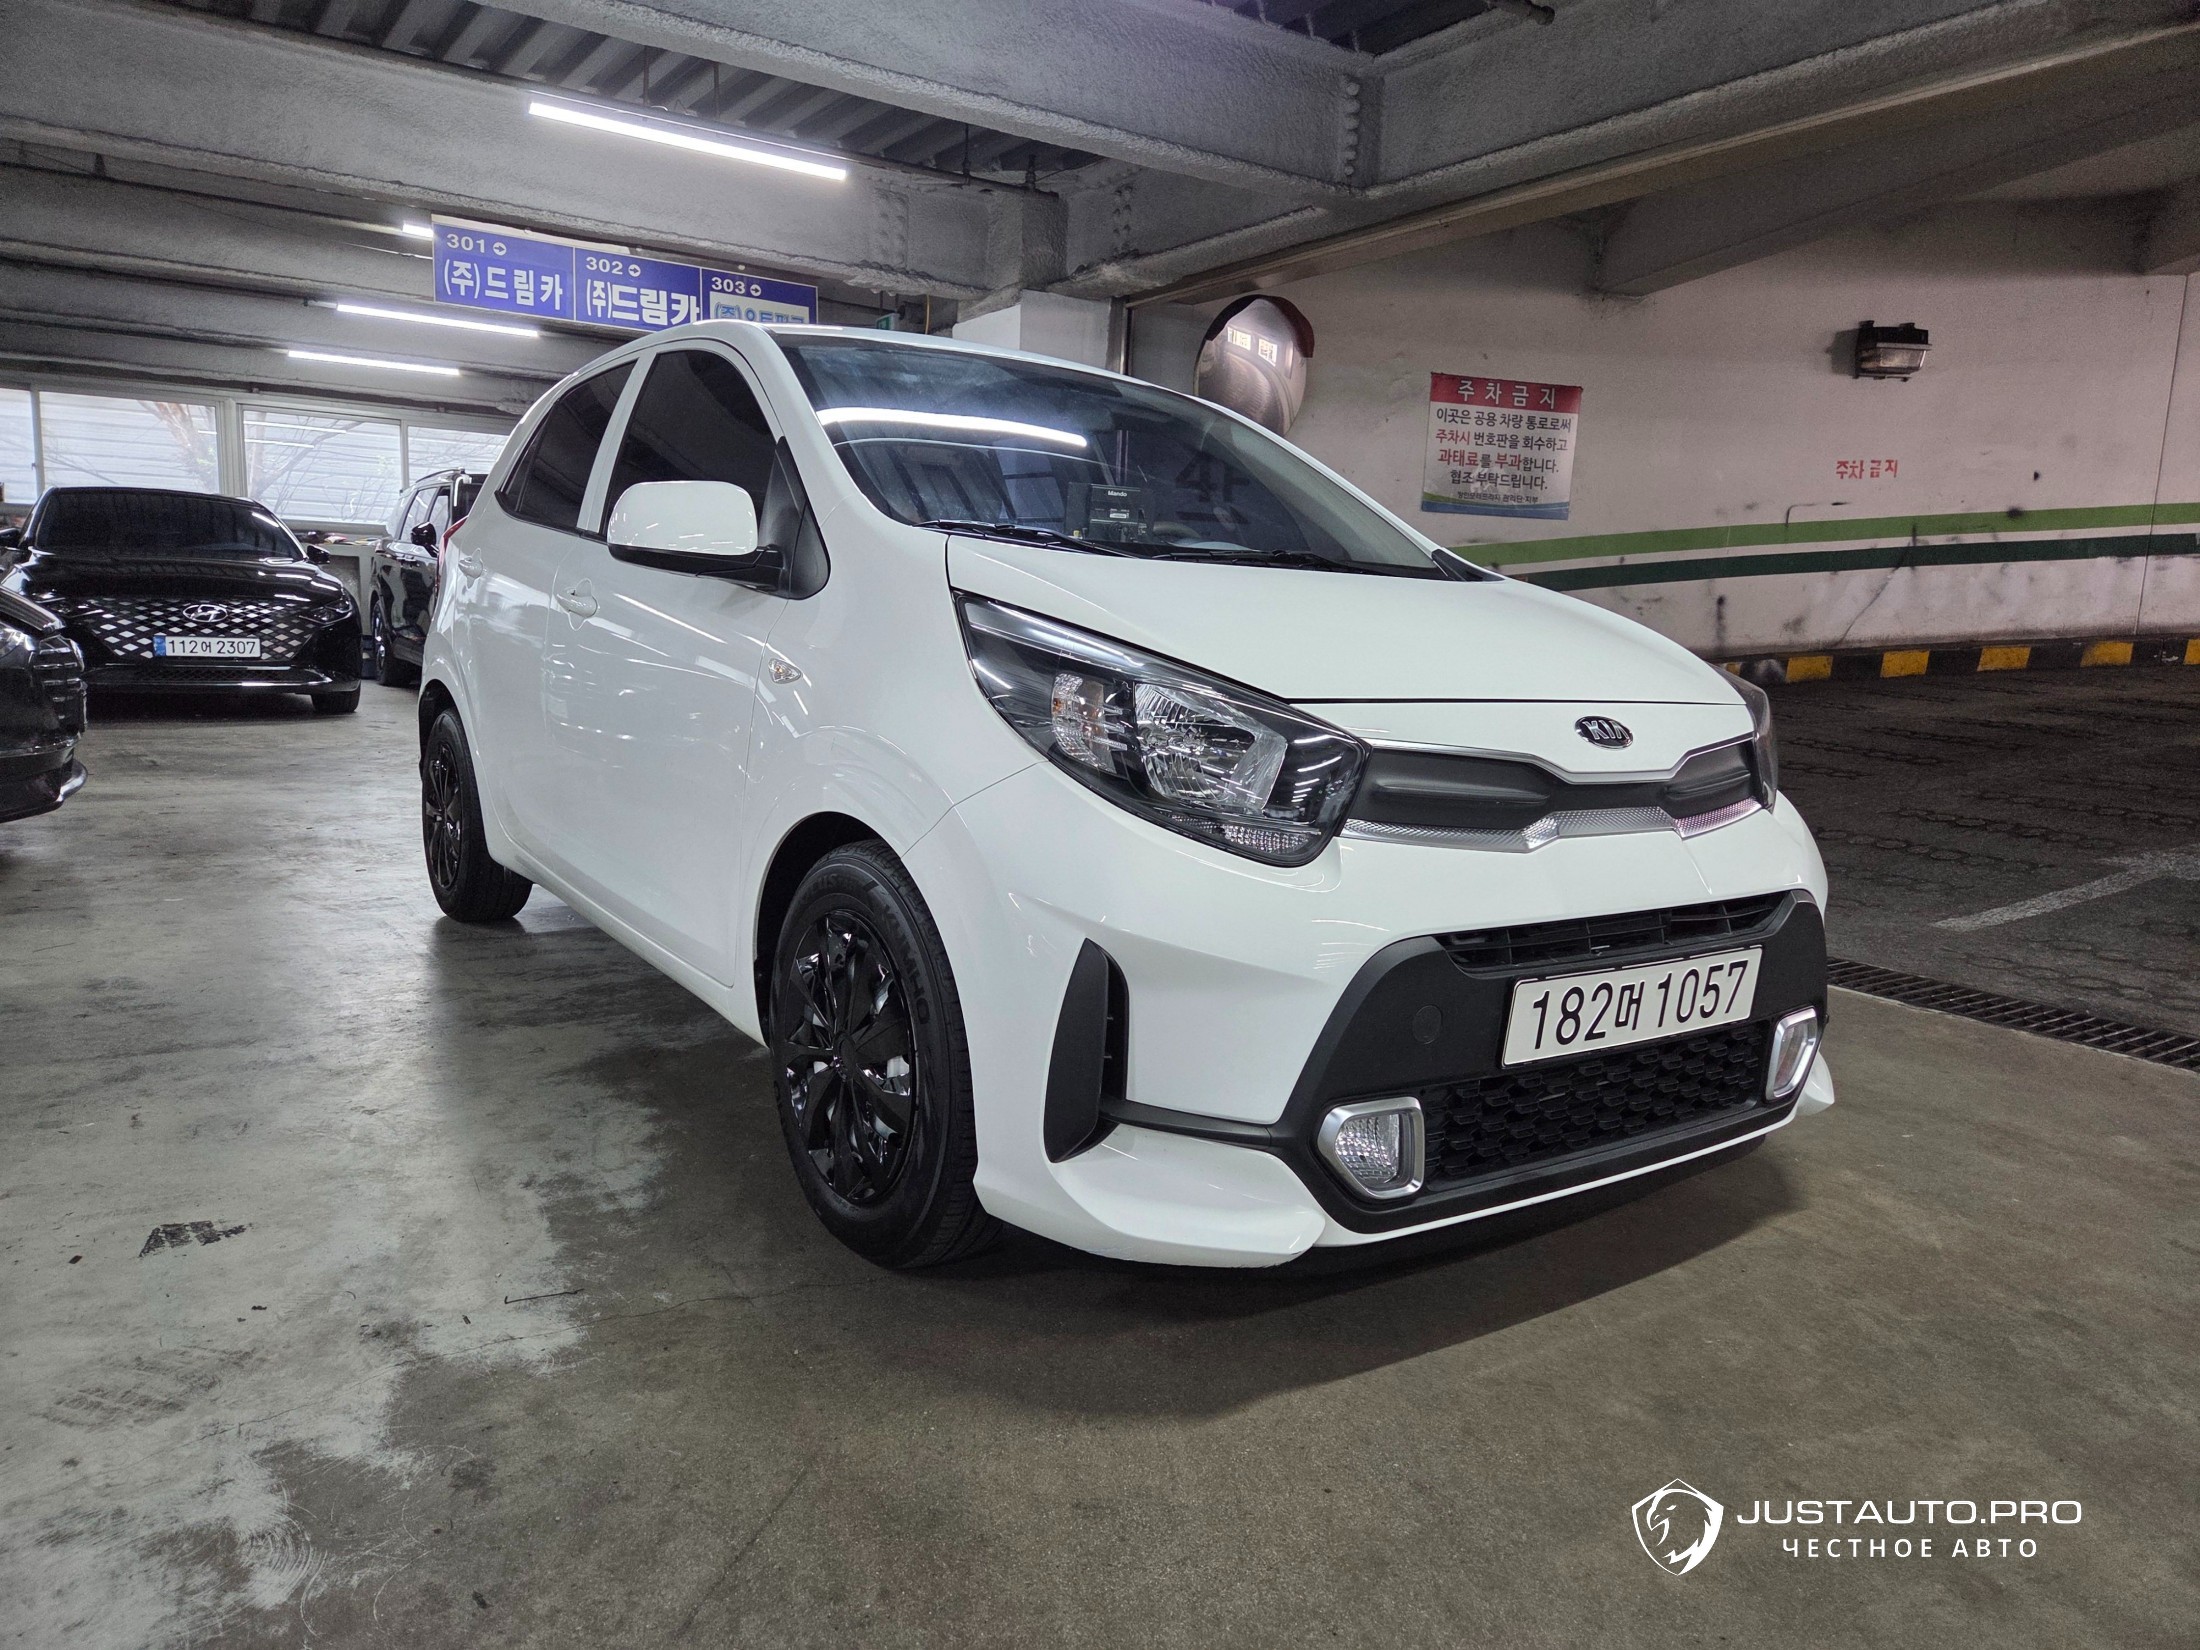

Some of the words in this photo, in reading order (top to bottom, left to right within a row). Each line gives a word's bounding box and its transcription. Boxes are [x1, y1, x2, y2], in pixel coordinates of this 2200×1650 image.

[446, 233, 486, 253] 301
[586, 256, 623, 275] 302
[711, 276, 746, 294] 303
[586, 278, 700, 327] (주)드림카
[1436, 408, 1471, 425] 이곳은
[1474, 411, 1497, 427] 공용
[1500, 413, 1523, 429] 차량
[1526, 415, 1571, 433] 통로로써
[1436, 429, 1471, 445] 주차시
[1474, 432, 1520, 448] 번호판을
[1522, 435, 1568, 452] 회수하고
[1438, 449, 1492, 468] 과태료를
[1495, 453, 1559, 473] 부과합니다.
[216, 641, 256, 654] 2307
[1582, 719, 1630, 740] KIA
[1656, 959, 1749, 1028] 1057
